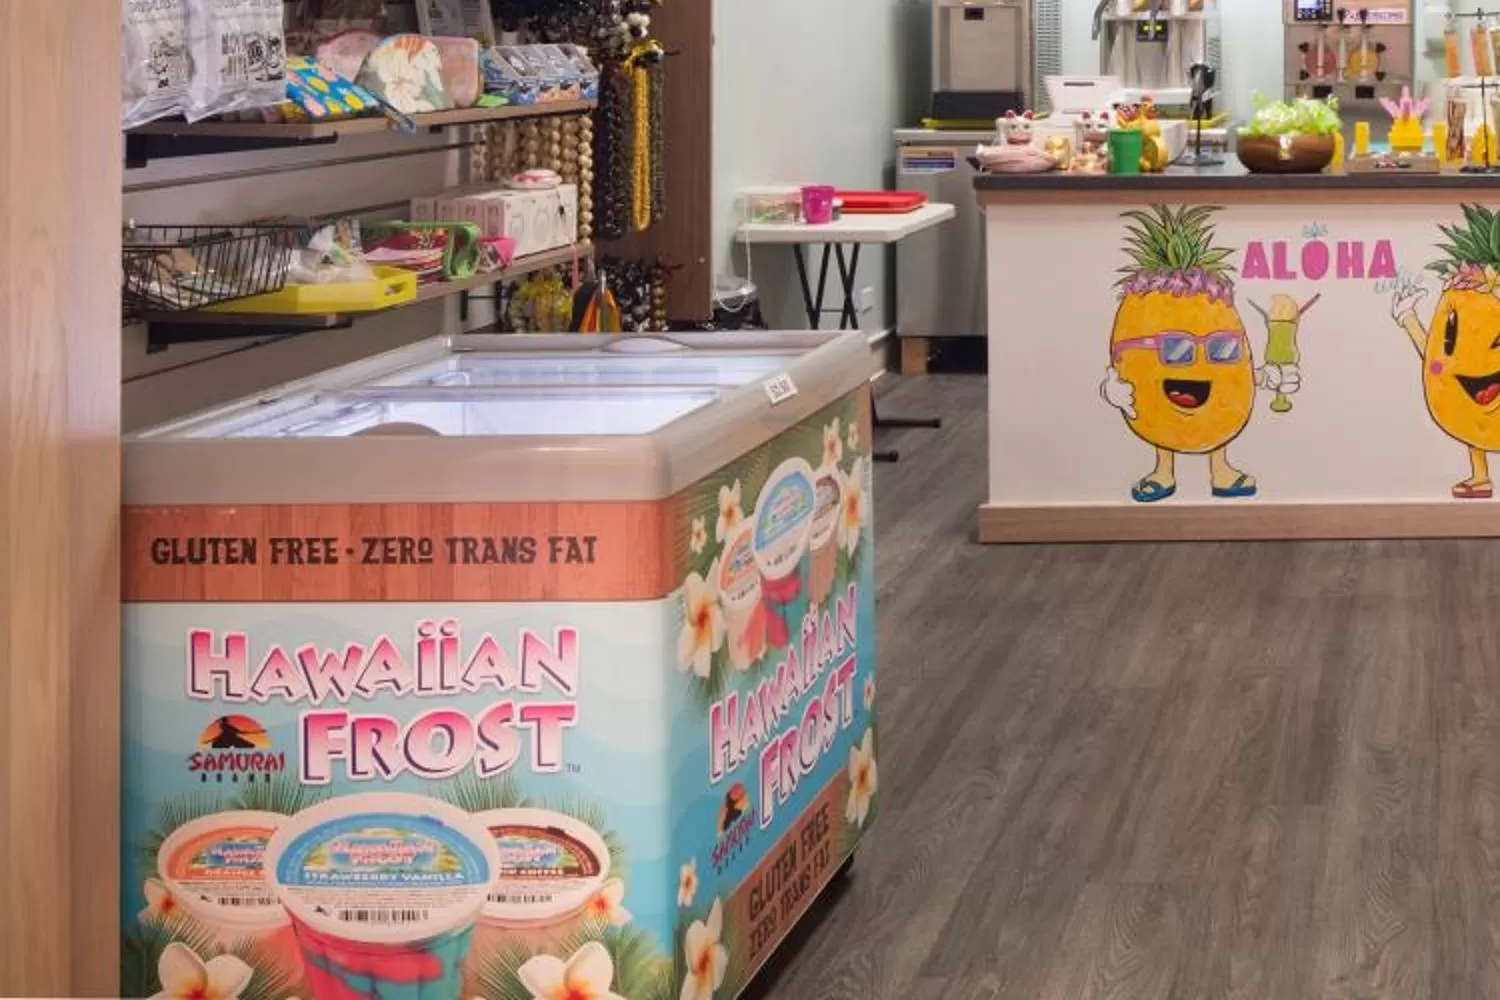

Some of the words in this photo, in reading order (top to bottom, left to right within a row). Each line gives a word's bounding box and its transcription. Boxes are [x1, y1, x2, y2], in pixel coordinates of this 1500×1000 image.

[1241, 239, 1398, 281] ALOHA
[151, 536, 258, 565] GLUTEN
[269, 537, 339, 565] FREE
[444, 537, 538, 564] TRANS
[548, 537, 598, 564] FAT
[187, 750, 285, 772] SAMURAI
[299, 701, 579, 786] FROST
[759, 653, 858, 831] FROST
[749, 839, 797, 922] GLUTEN
[800, 801, 832, 862] FREE
